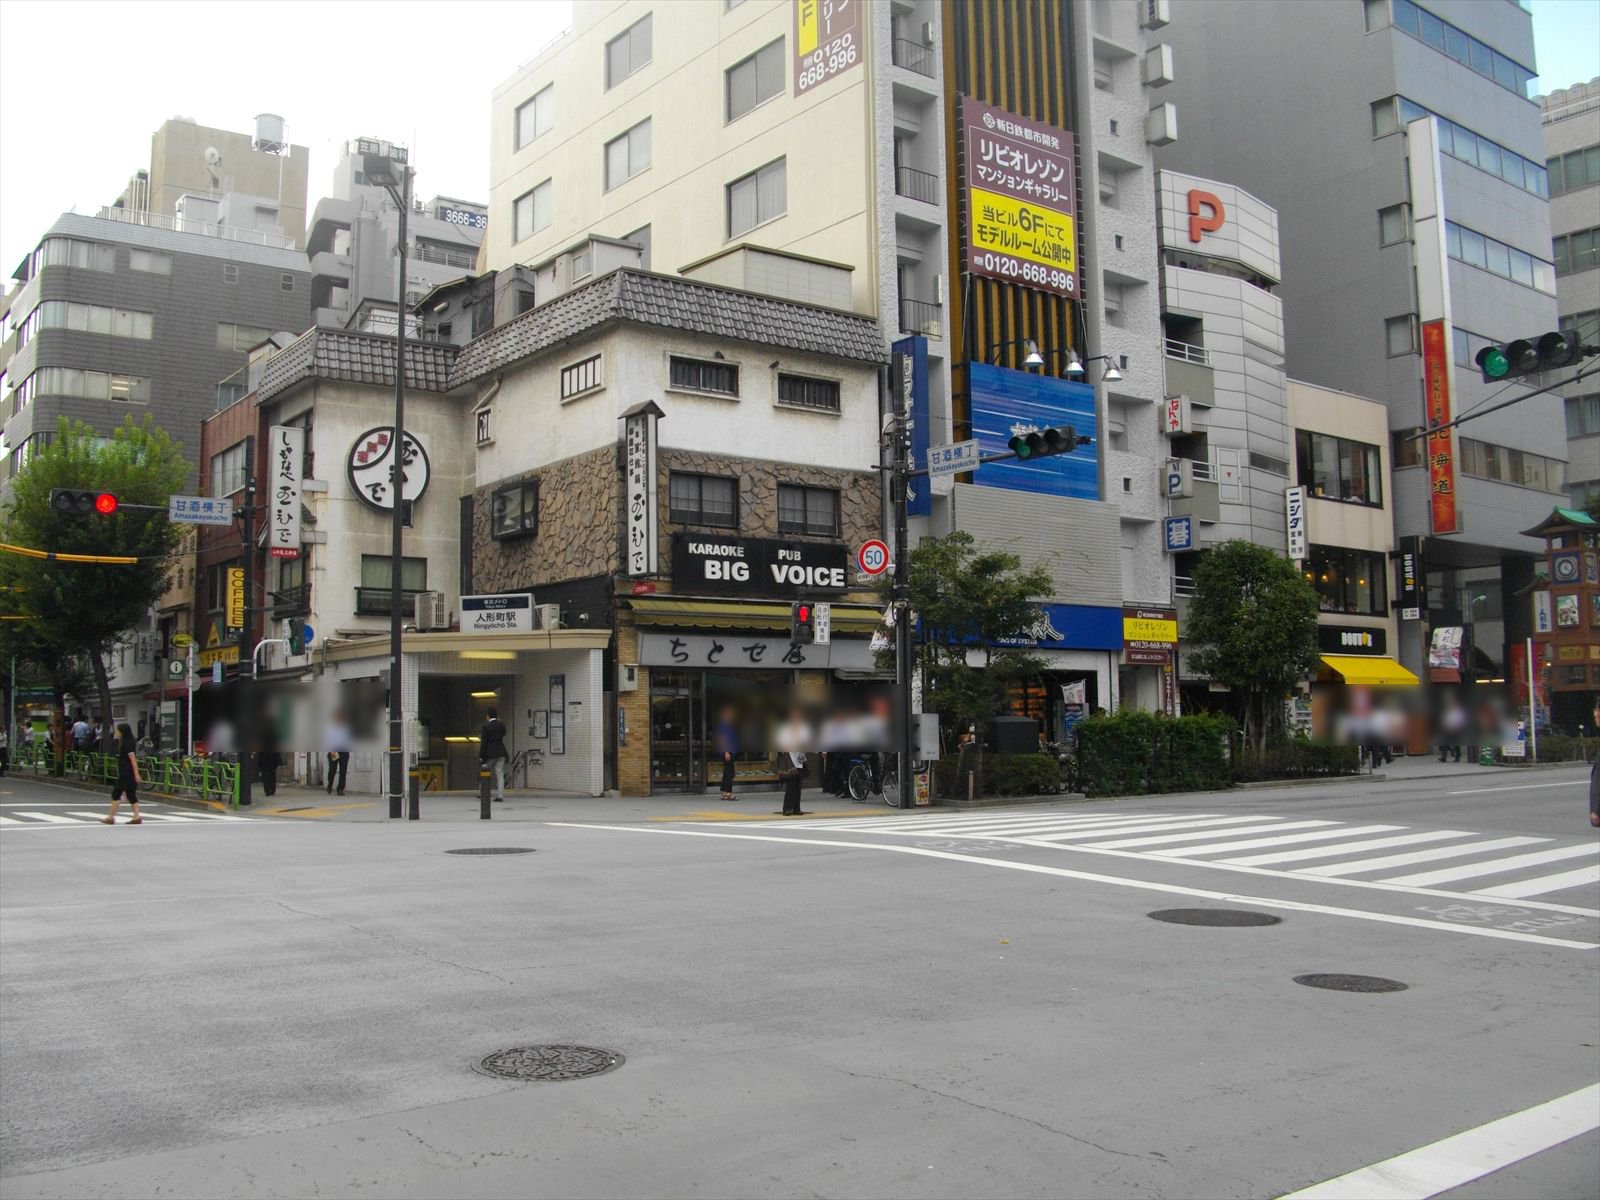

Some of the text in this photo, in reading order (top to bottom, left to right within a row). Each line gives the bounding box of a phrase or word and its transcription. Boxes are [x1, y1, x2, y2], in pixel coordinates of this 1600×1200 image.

[823, 0, 833, 35] リー
[813, 33, 852, 63] 0120
[799, 45, 856, 89] 668-996
[996, 117, 1060, 150] 新日鉄都市開発
[980, 138, 1065, 184] リビオレゾン
[976, 163, 1069, 202] マンションギャラリー
[446, 209, 487, 229] 3666-36
[982, 205, 1065, 242] 当ビル6Fにて
[1187, 188, 1225, 243] P
[976, 223, 1071, 265] モデルルーム公開中
[984, 253, 1074, 292] 0120-668-996
[932, 444, 974, 464] 甘酒横丁
[1168, 474, 1181, 494] P
[175, 499, 227, 513] 甘酒横丁
[688, 543, 801, 561] KARAOKE PUB
[865, 550, 883, 565] 50
[704, 559, 845, 587] BIG VOICE
[231, 569, 245, 626] COFFEE
[476, 611, 516, 622] 人形町駅
